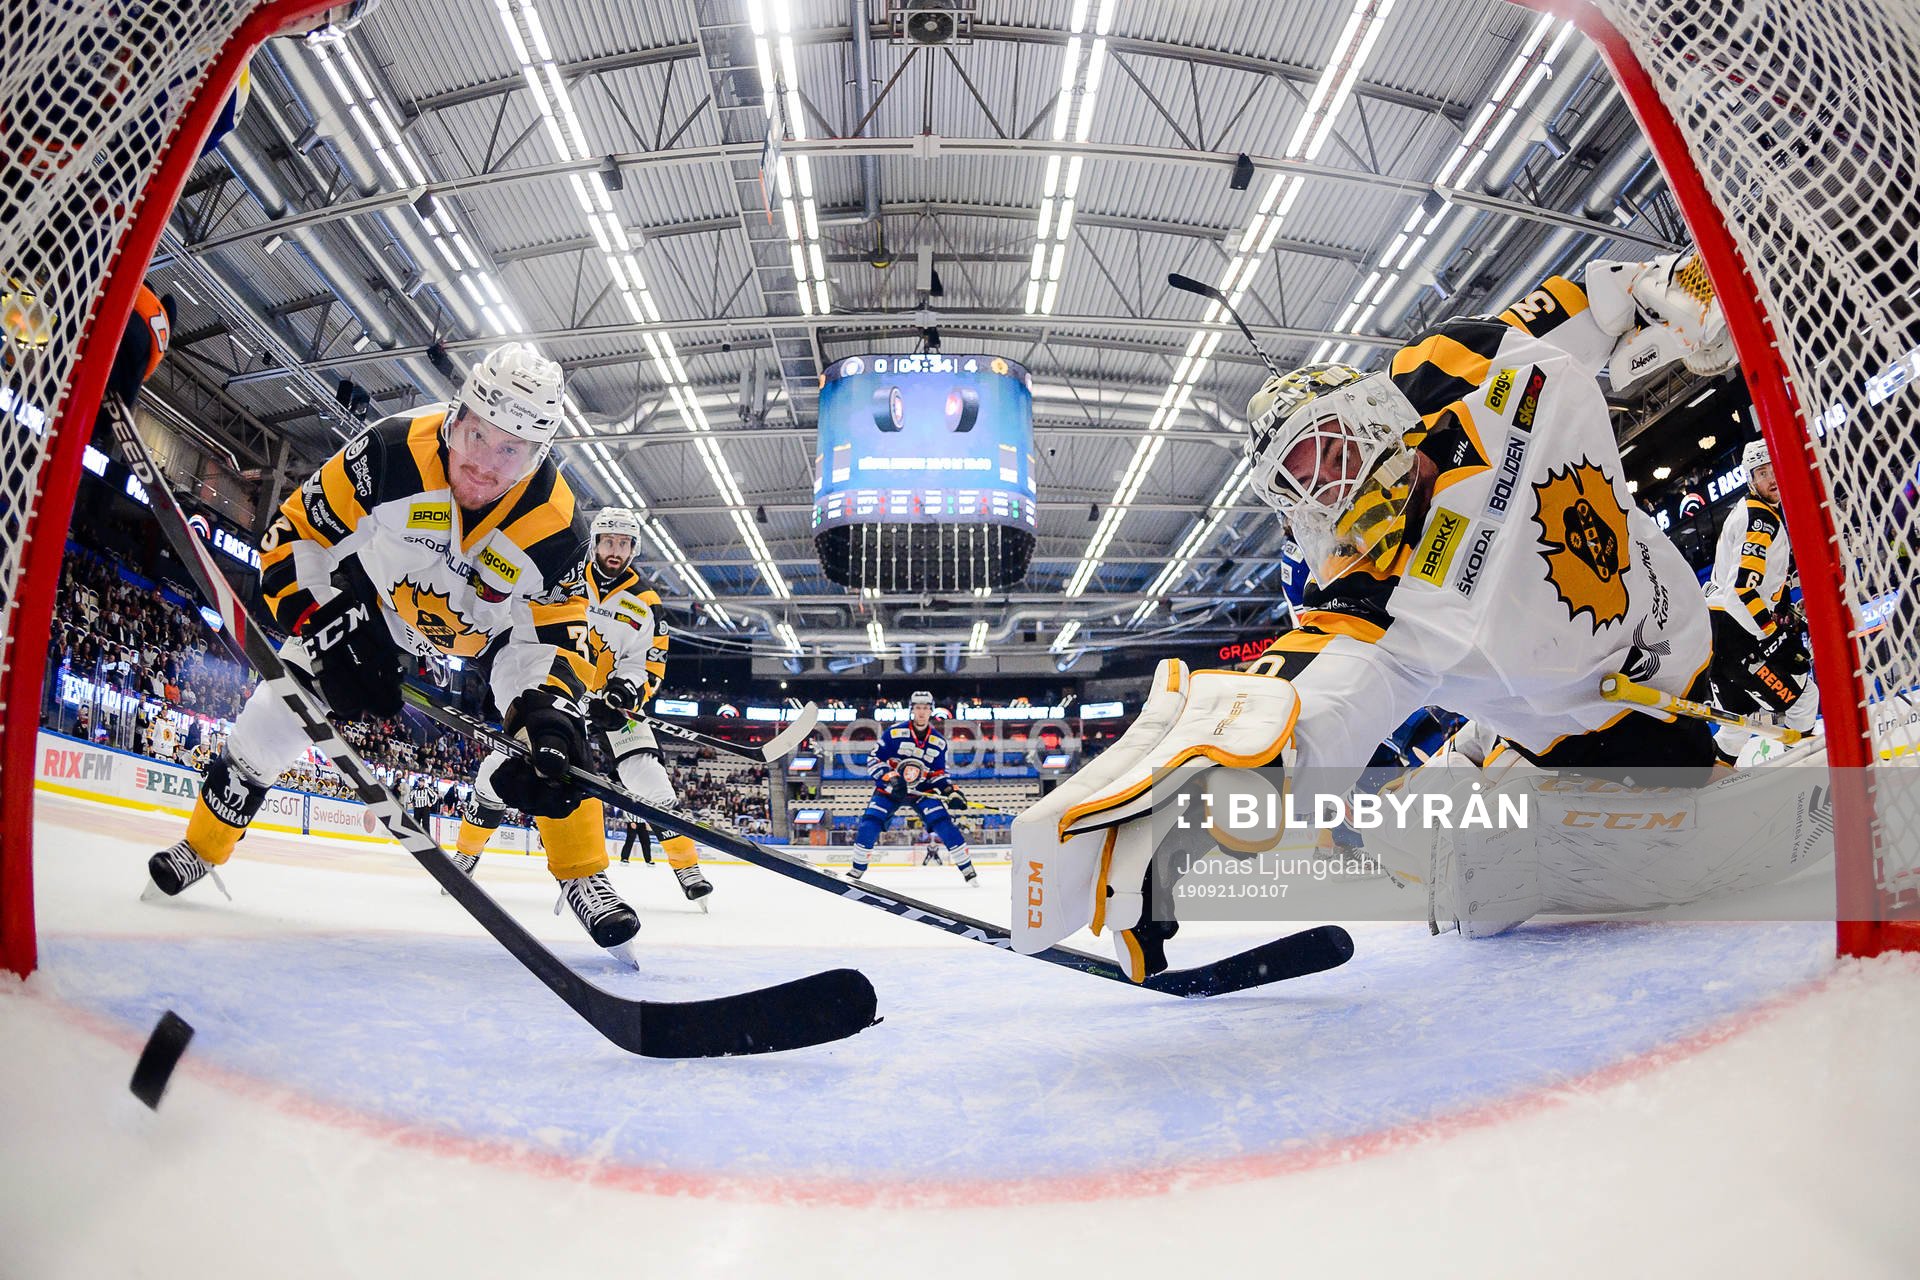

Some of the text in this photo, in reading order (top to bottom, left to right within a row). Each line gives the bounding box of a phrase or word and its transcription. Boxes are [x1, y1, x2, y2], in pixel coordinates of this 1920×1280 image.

[511, 370, 542, 388] CCM
[874, 358, 978, 373] 0 04:34 4
[1491, 369, 1511, 408] engc
[103, 400, 153, 484] PEED
[1453, 440, 1469, 466] SHL
[1489, 437, 1526, 512] BOLIDEN
[311, 505, 324, 527] Kraft
[412, 510, 450, 521] BROK
[1421, 517, 1457, 578] BROKK
[480, 550, 516, 579] ngcon
[1456, 528, 1495, 596] ŠKODA
[589, 605, 613, 618] OLIDEN
[620, 600, 647, 616] engcon
[301, 602, 370, 660] CCM
[1763, 631, 1788, 657] CCM
[1756, 665, 1797, 704] REPAY
[473, 728, 523, 758] RIBC
[539, 746, 566, 760] CCM
[205, 788, 251, 825] NORRAN
[313, 805, 362, 827] Swedbank
[1561, 810, 1688, 830] CCM
[1028, 860, 1043, 930] CCM
